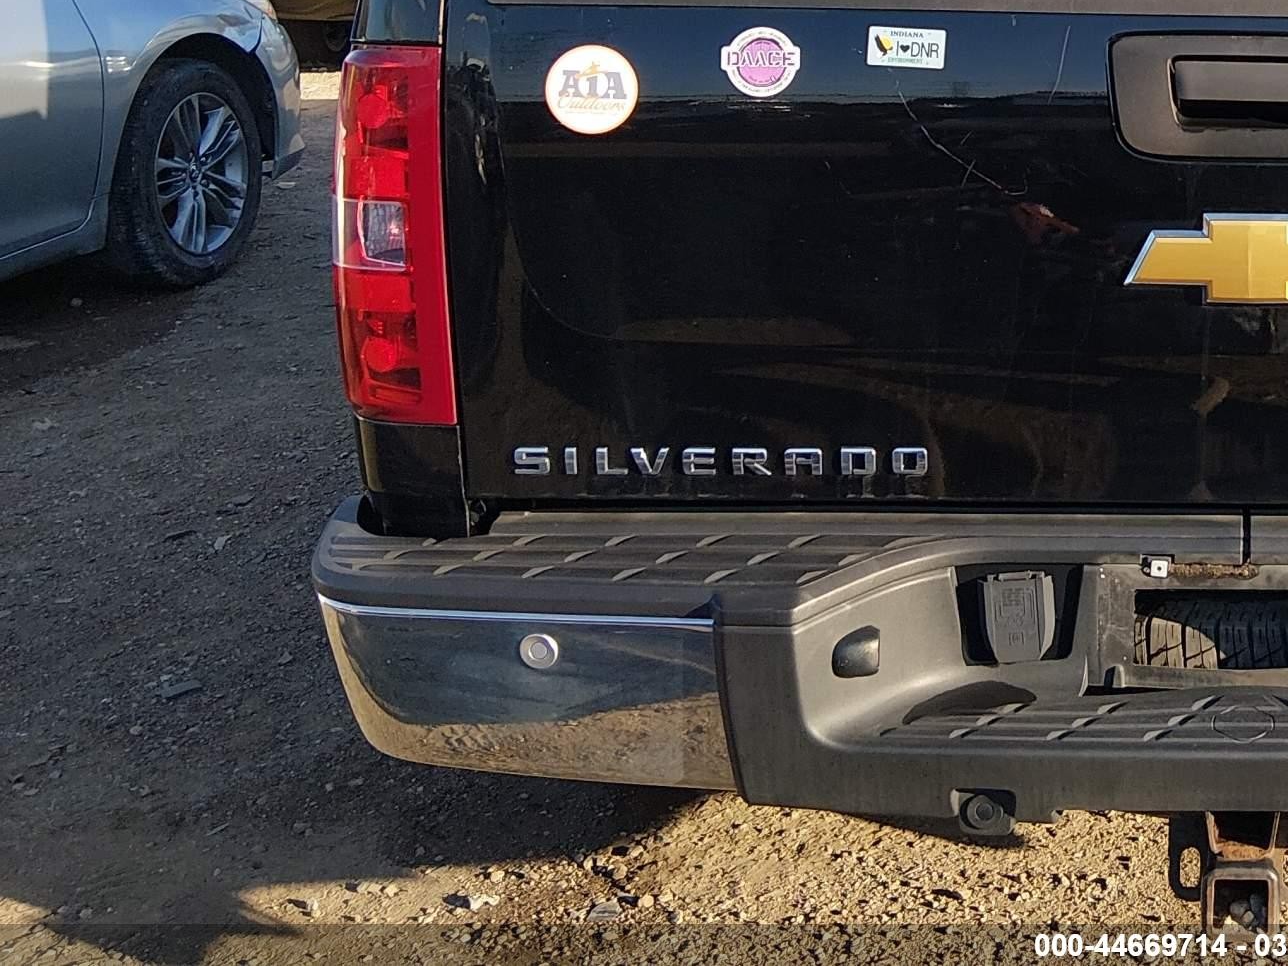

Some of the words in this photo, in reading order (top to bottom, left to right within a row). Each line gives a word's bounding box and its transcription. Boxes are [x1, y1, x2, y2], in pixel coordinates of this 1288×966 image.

[890, 30, 924, 38] INDIANA
[911, 42, 940, 58] DNR
[513, 446, 930, 476] SILVERADO
